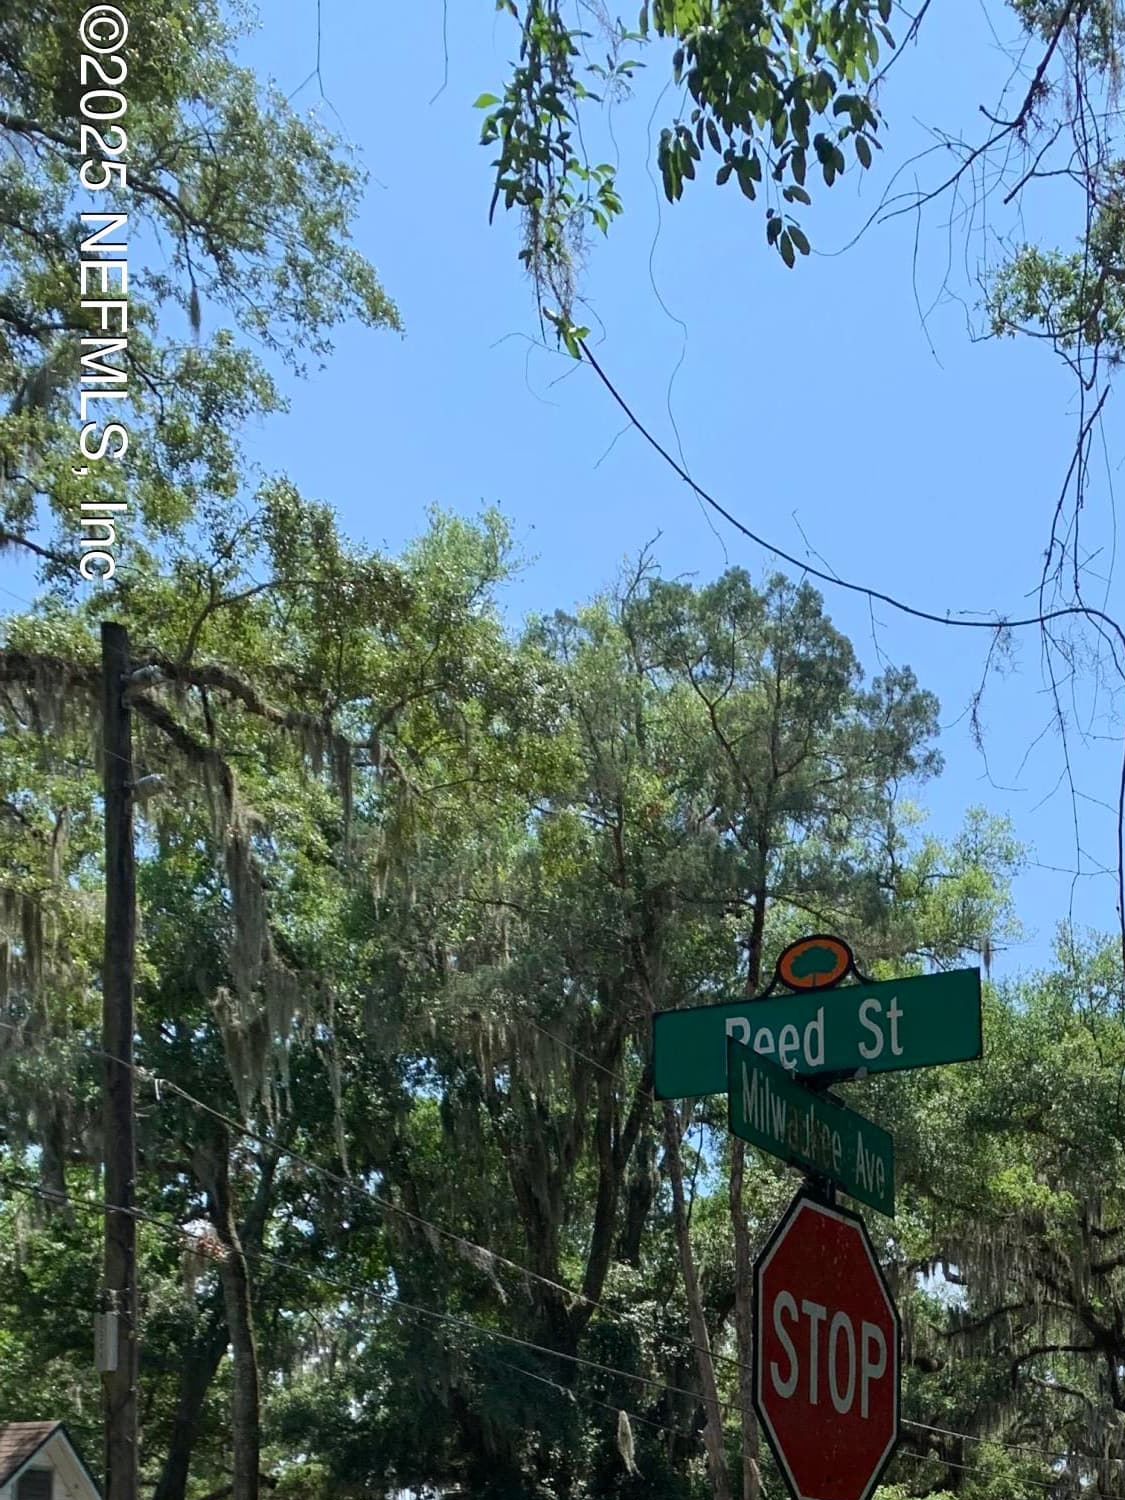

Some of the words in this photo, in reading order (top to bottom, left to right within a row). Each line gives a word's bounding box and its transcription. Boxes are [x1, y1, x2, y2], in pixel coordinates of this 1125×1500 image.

[858, 996, 904, 1060] St
[855, 1130, 886, 1199] Ave
[769, 1290, 888, 1419] STOP
